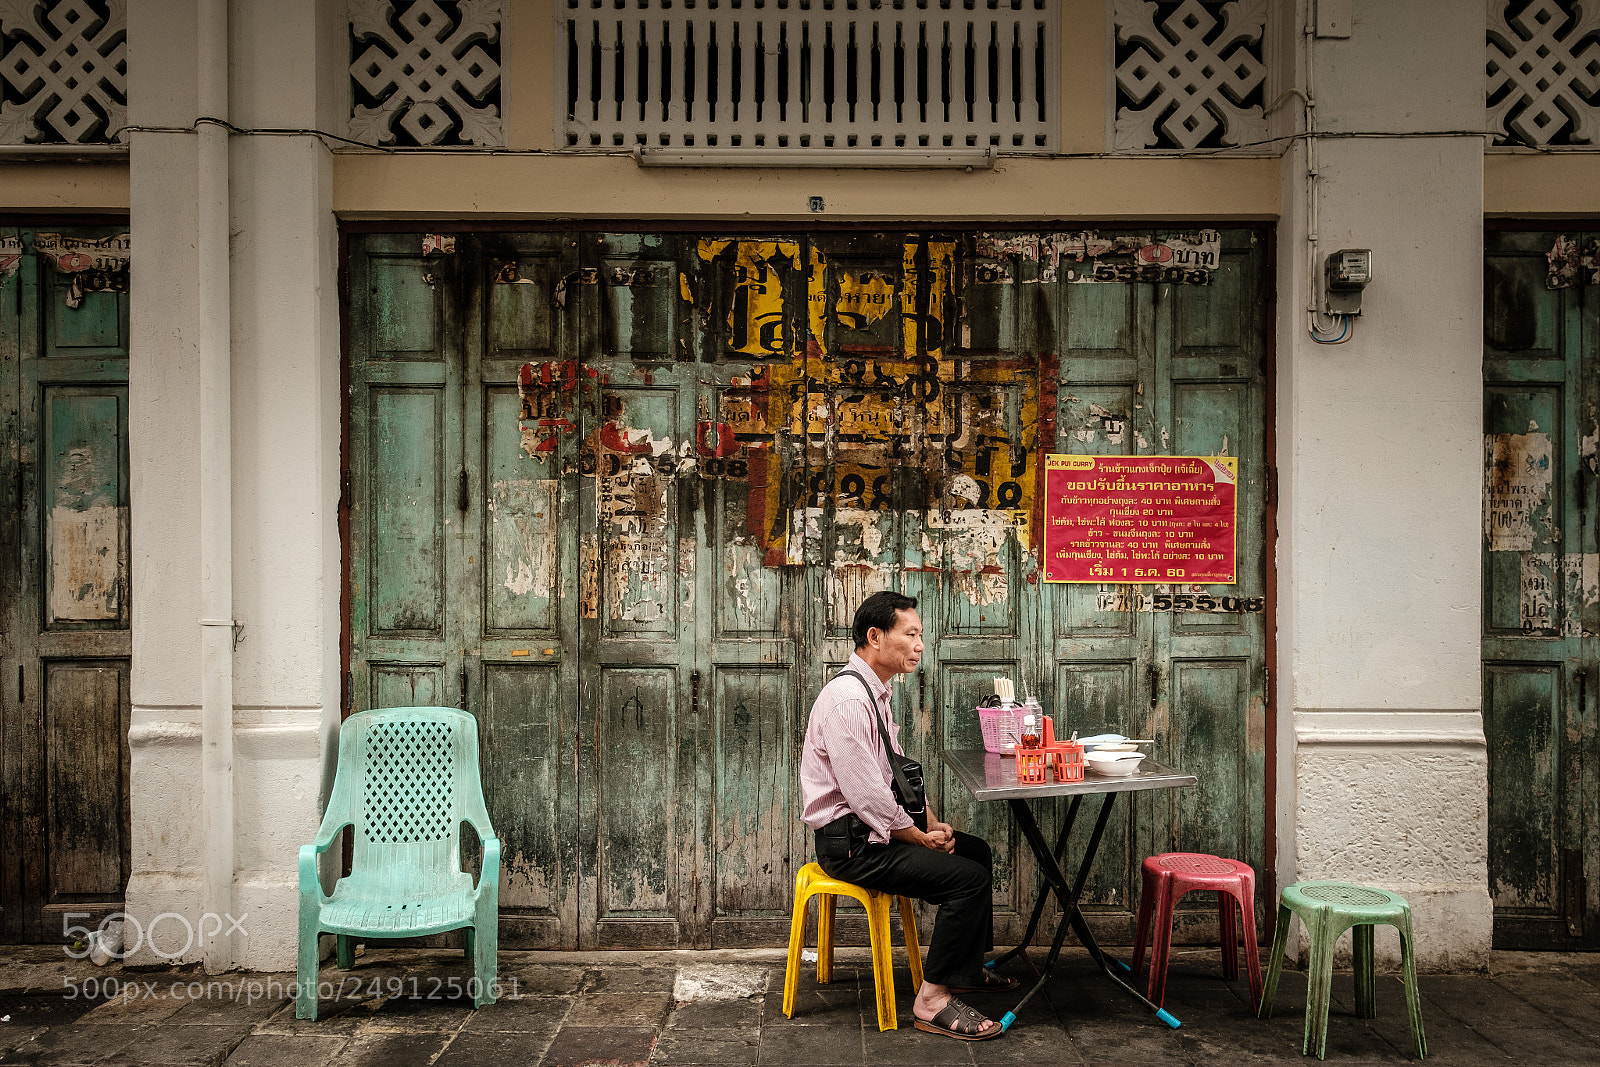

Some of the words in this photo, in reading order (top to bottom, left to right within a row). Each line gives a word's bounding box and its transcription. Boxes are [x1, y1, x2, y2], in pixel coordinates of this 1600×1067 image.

[1067, 475, 1214, 491] ขอปรับขึ้นราคาอาหาร
[1090, 561, 1113, 576] เริ่ม
[1121, 567, 1127, 577] 1
[1134, 568, 1161, 577] ธ.ค.
[1167, 568, 1185, 577] 60
